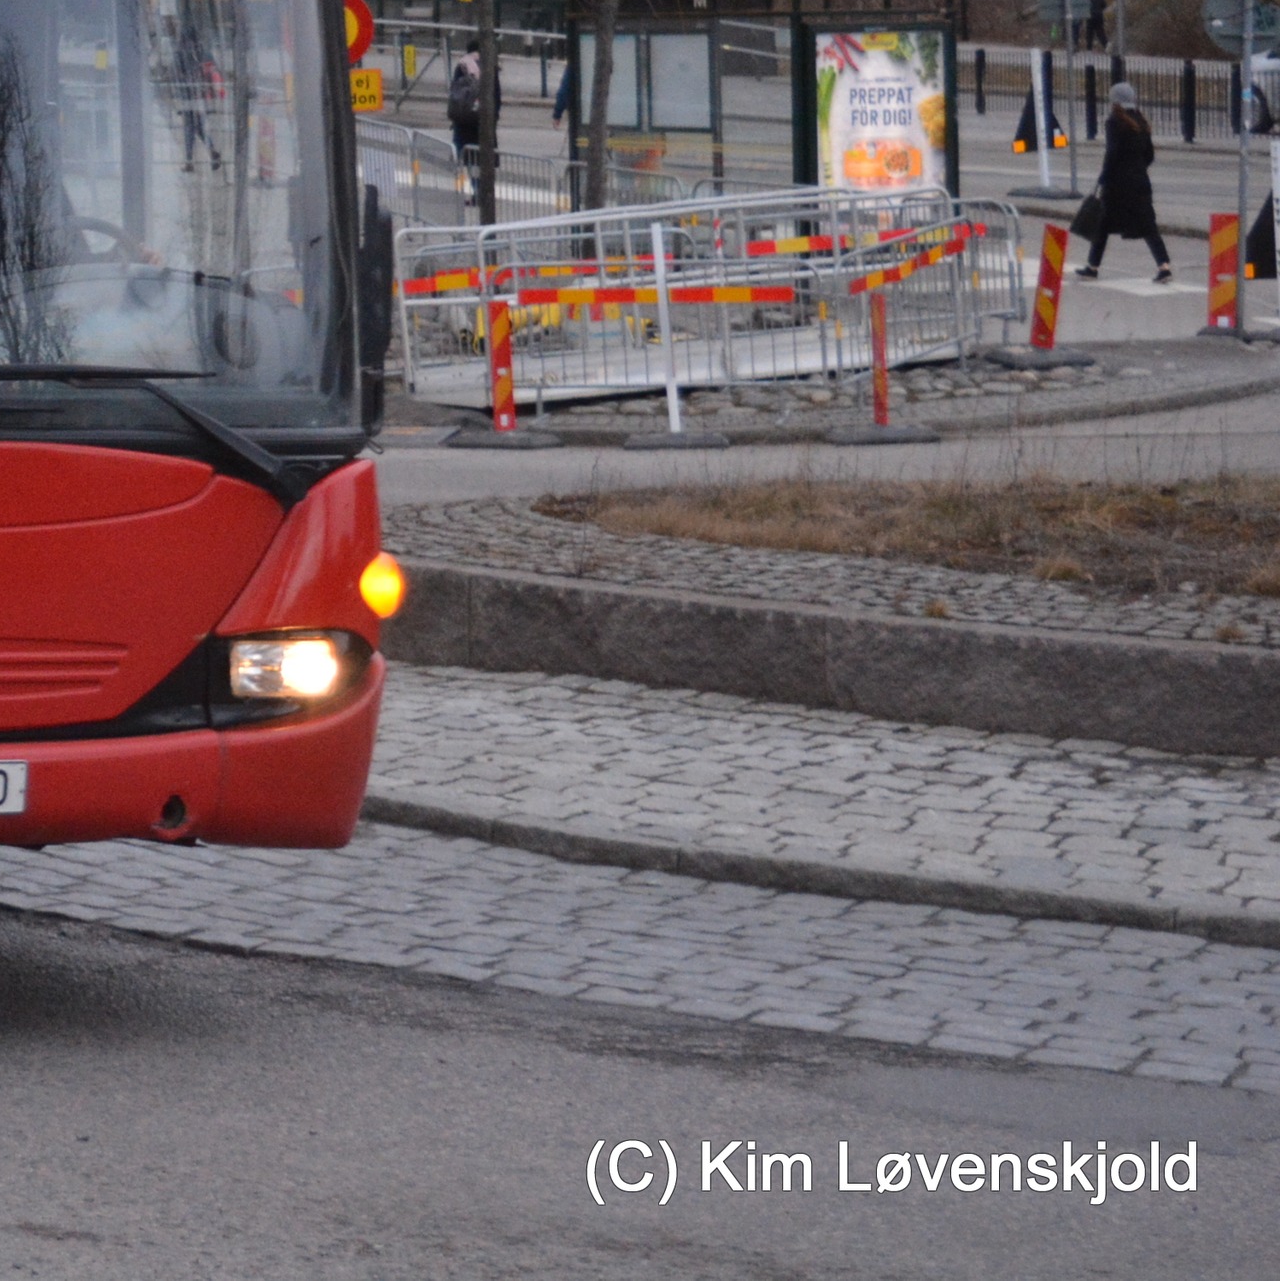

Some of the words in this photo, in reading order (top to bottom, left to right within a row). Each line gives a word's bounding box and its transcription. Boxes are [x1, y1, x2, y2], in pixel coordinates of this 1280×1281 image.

[356, 76, 370, 90] ej
[849, 87, 913, 106] PREPPAT
[851, 106, 878, 126] FÖR
[883, 109, 912, 127] DIG!
